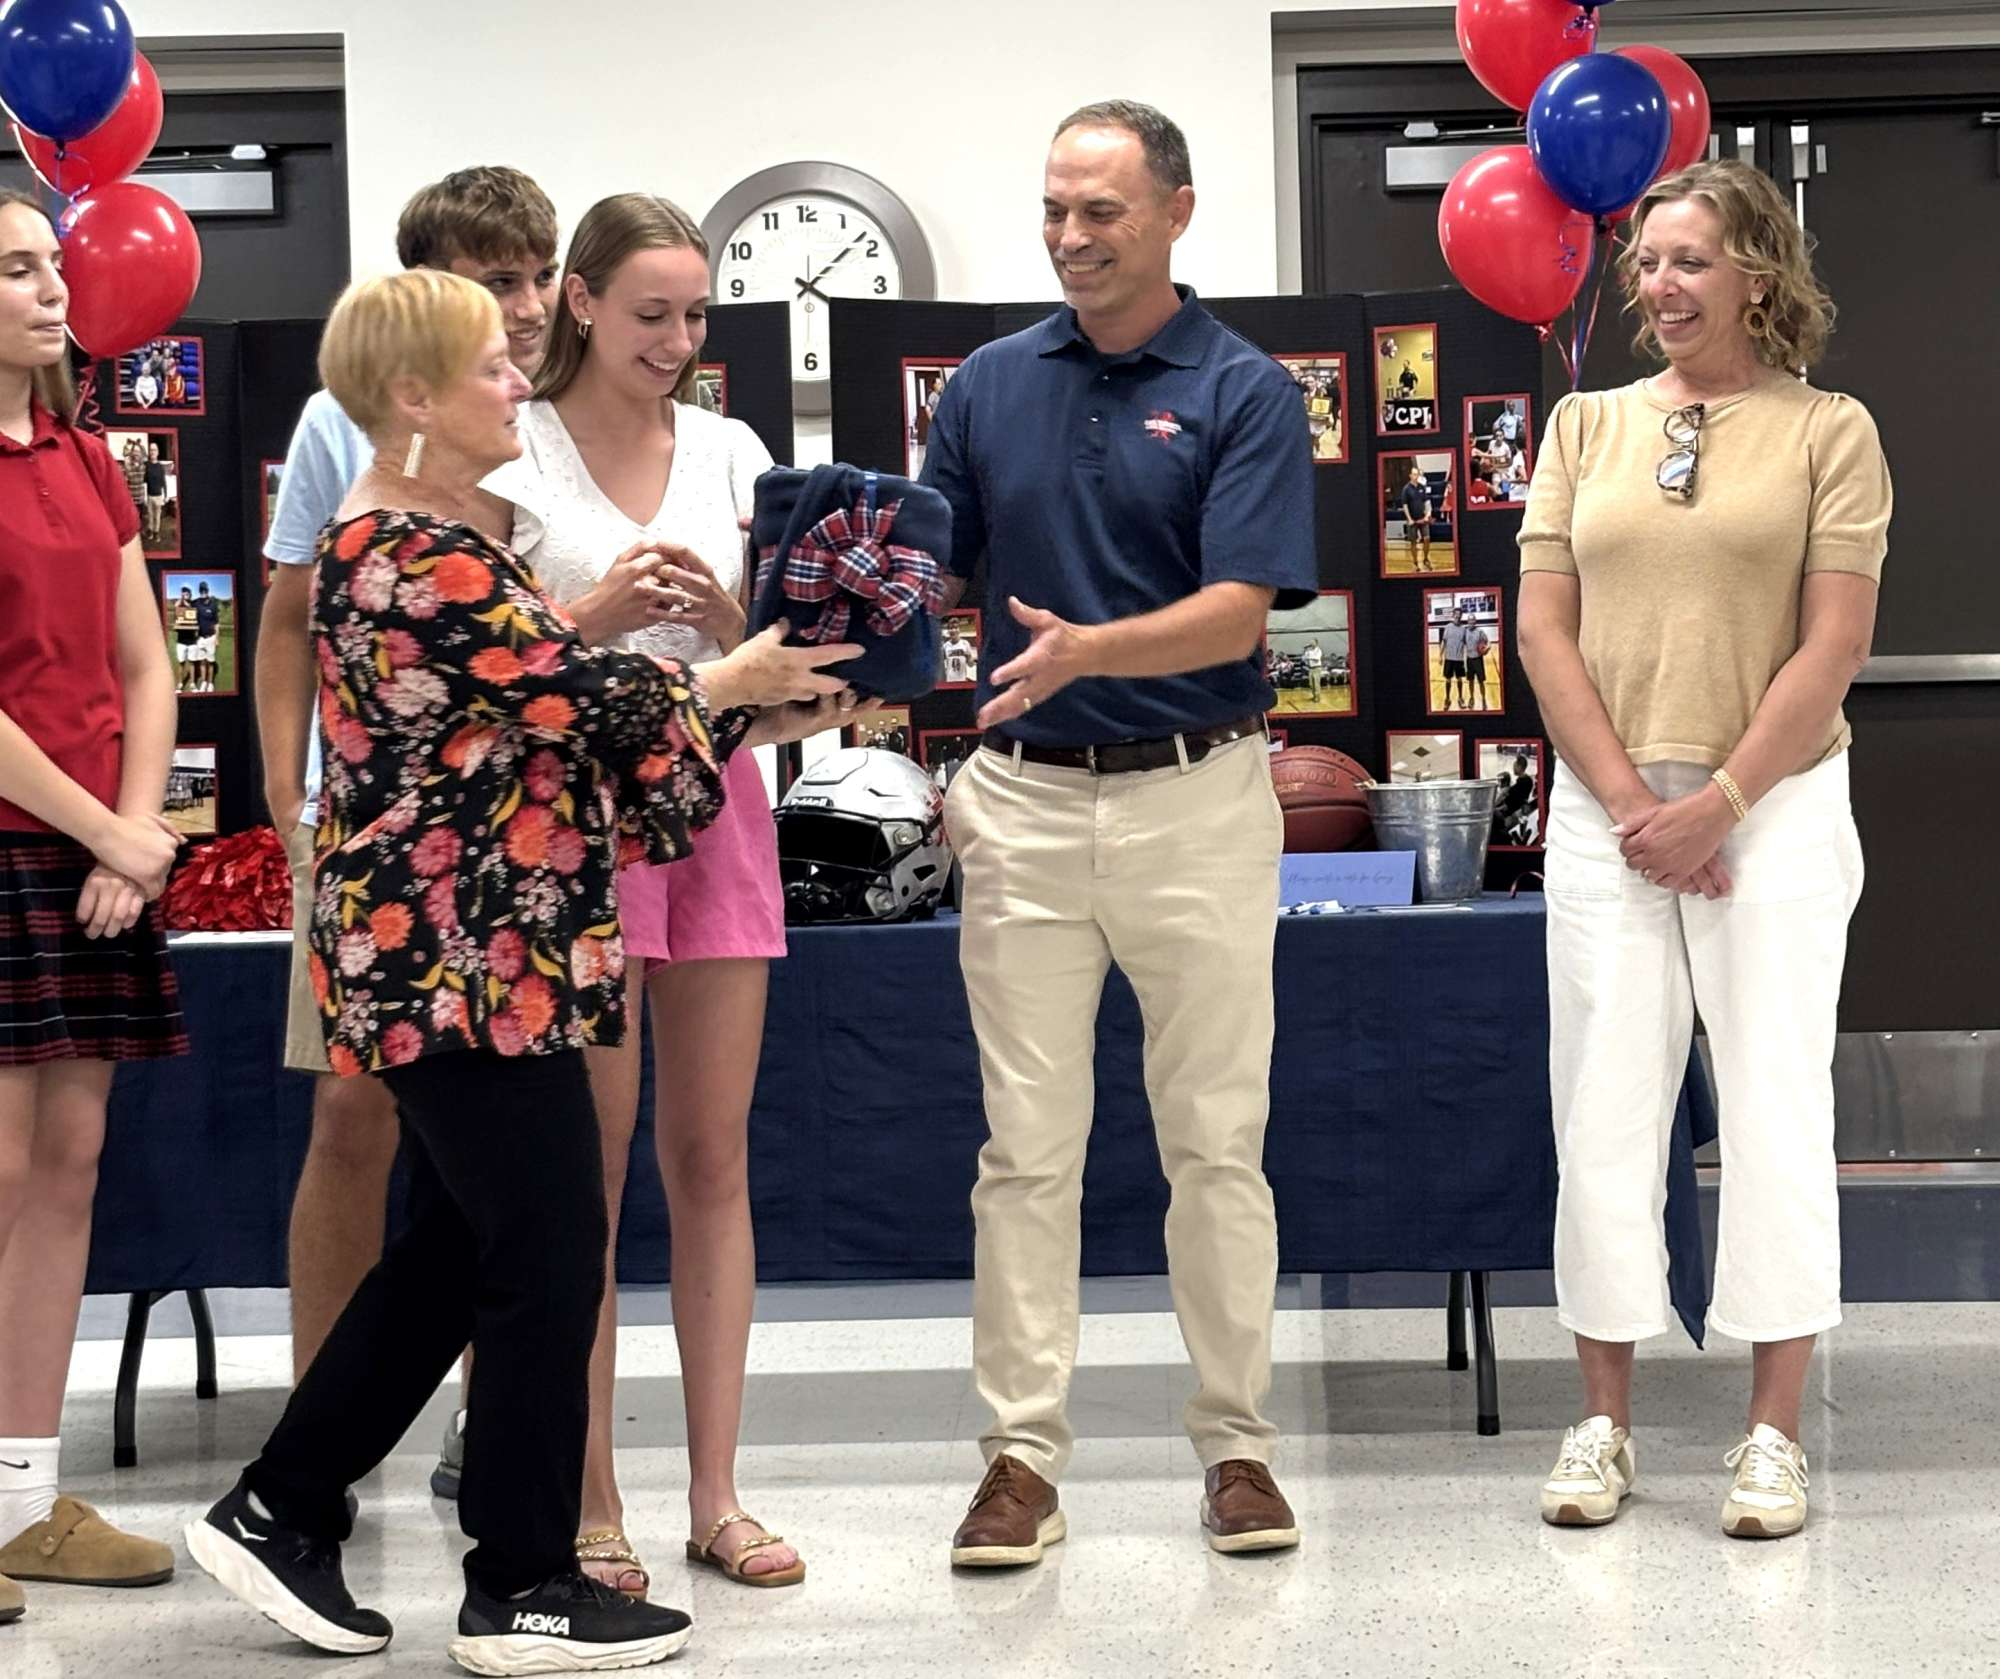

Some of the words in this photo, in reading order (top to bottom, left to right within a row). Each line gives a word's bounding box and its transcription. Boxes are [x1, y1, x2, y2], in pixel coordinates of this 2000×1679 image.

[762, 212, 779, 230] 11
[796, 205, 818, 223] 12
[837, 213, 846, 229] 1
[729, 241, 752, 261] 10
[866, 239, 879, 258] 2
[730, 278, 745, 298] 9
[874, 275, 888, 294] 3
[804, 352, 818, 371] 6
[511, 1611, 570, 1635] HOKA
